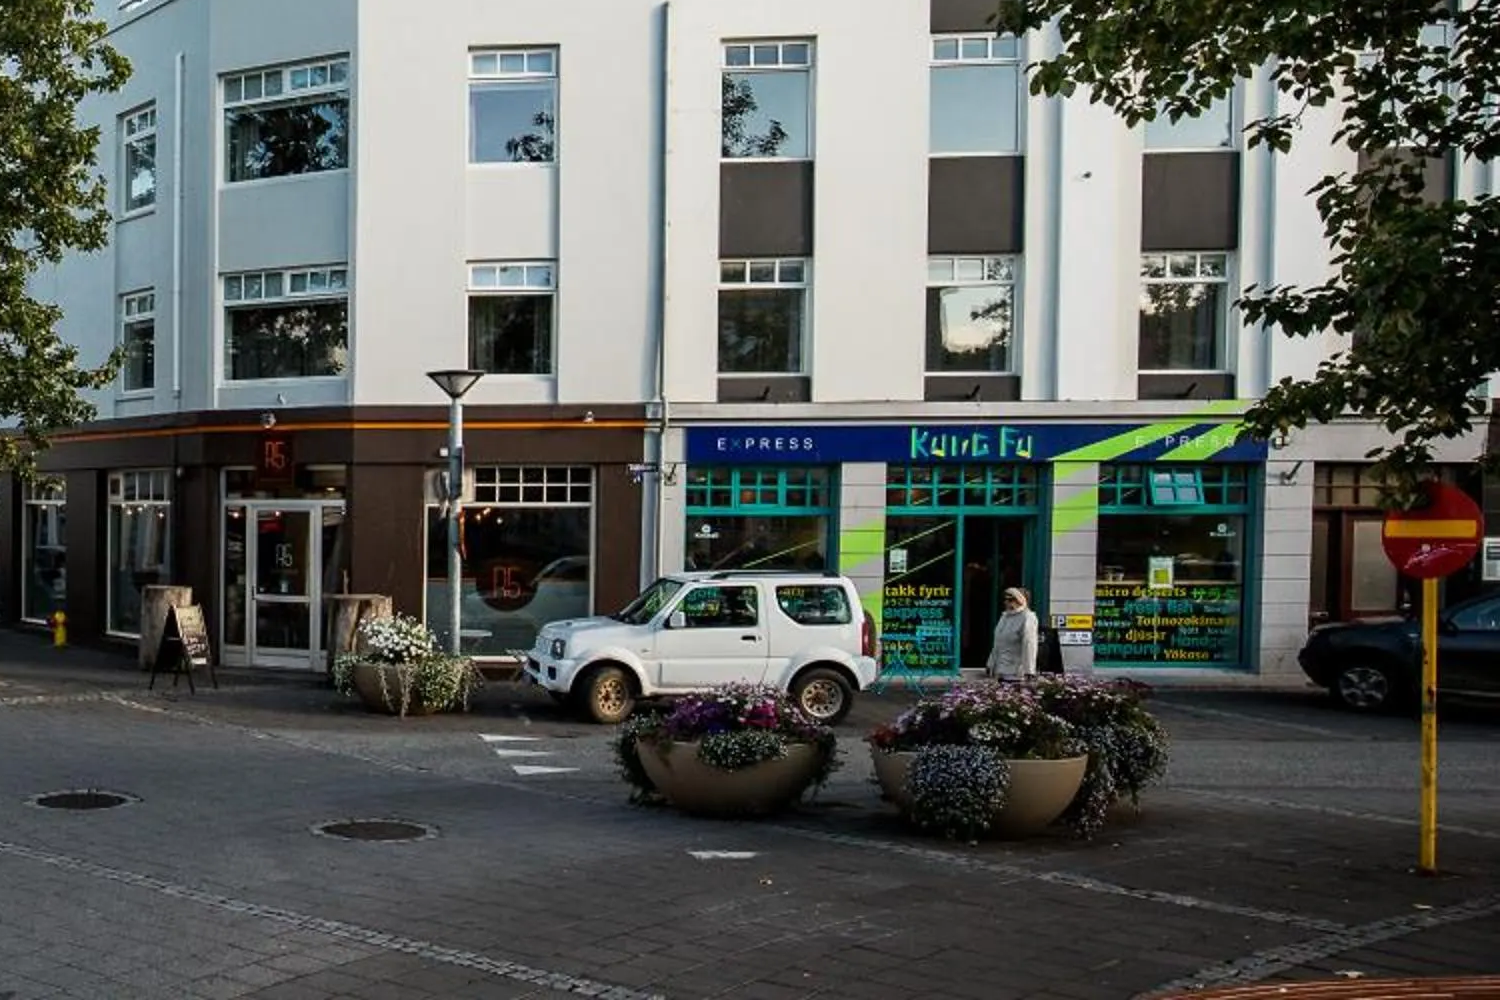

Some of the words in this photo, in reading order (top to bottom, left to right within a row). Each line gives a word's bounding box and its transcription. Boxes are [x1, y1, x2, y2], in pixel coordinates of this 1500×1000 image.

[717, 437, 814, 451] EXPRESS
[1134, 434, 1236, 448] EPRESS
[885, 585, 916, 597] takk
